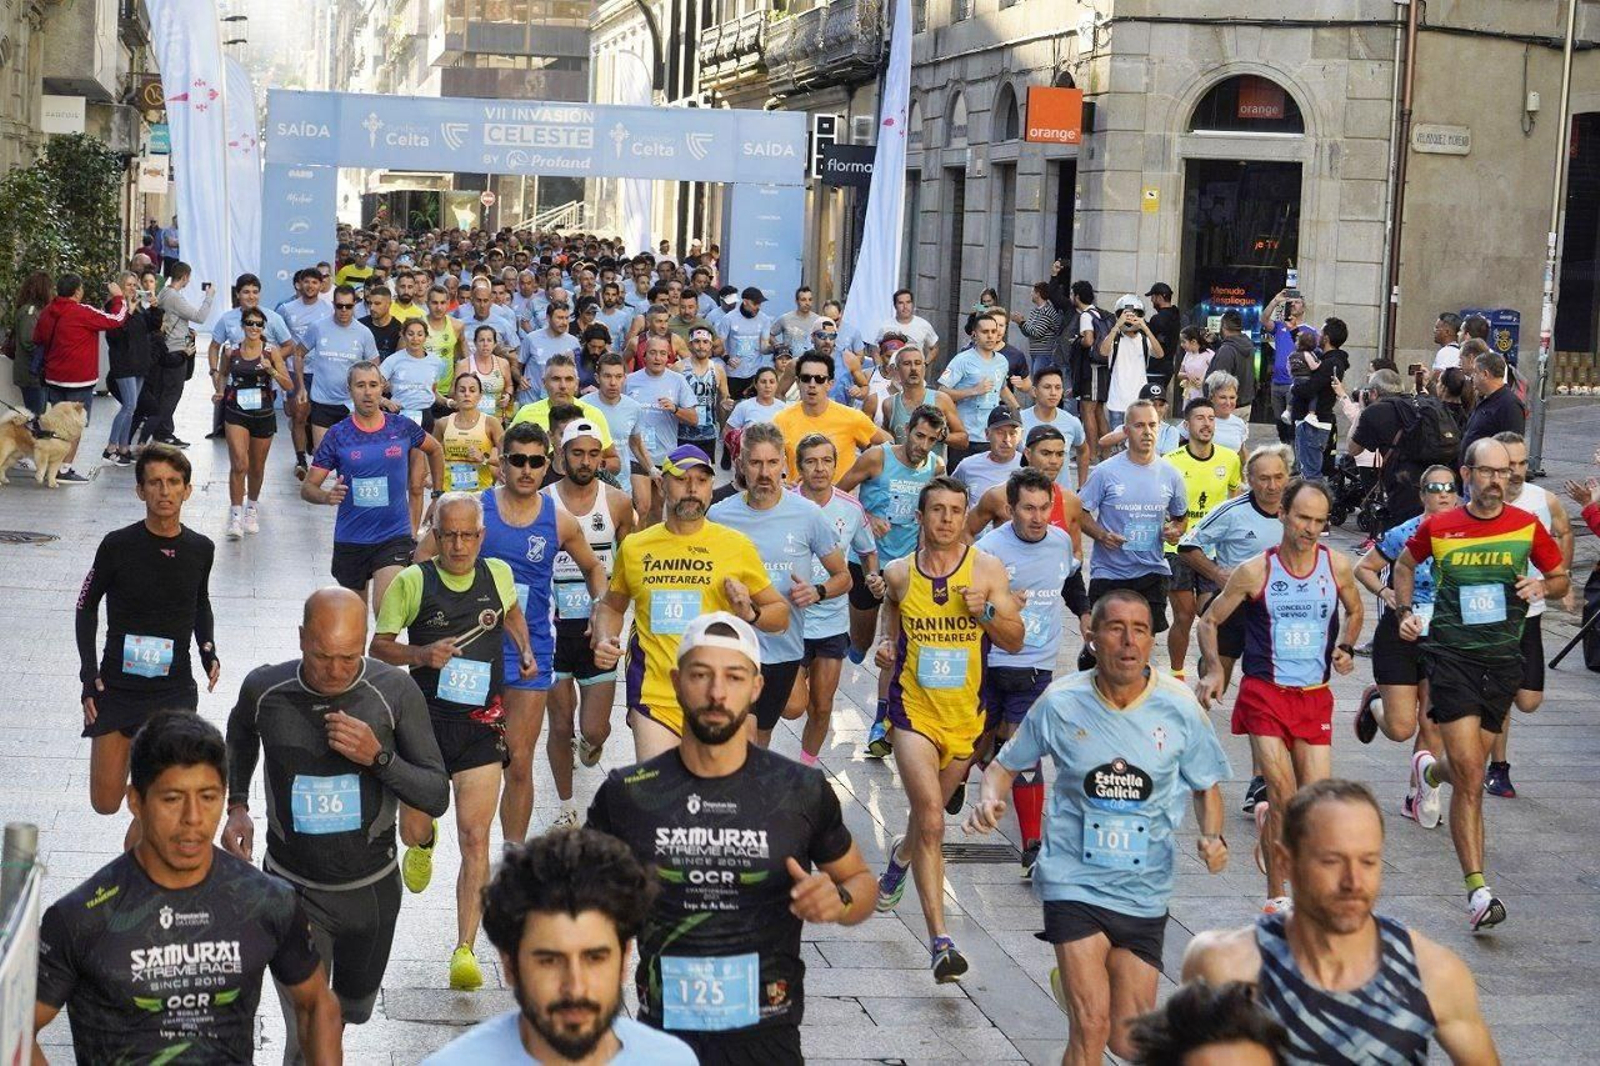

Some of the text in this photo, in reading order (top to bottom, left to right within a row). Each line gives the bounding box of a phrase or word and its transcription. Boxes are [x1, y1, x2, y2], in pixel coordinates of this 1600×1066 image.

[485, 107, 594, 123] VII INVASIÓN
[1240, 105, 1280, 117] orange
[278, 120, 331, 138] SAÍDA
[488, 125, 591, 147] CELESTE
[1029, 127, 1076, 142] orange
[386, 131, 430, 147] Celta
[631, 141, 675, 157] Celta
[743, 140, 795, 157] SAÍDA
[358, 486, 380, 498] 223
[643, 558, 714, 572] TANINOS
[1451, 551, 1514, 566] BIKILA
[642, 575, 712, 586] PONTEAREAS
[565, 594, 591, 607] 229
[1276, 604, 1312, 612] CONCELLO
[1468, 597, 1495, 611] 406
[664, 604, 684, 618] 40
[908, 616, 978, 631] TANINOS
[912, 632, 978, 643] PONTEAREAS
[1284, 632, 1311, 646] 383
[134, 648, 161, 664] 144
[932, 660, 951, 675] 36
[449, 671, 477, 690] 325
[1095, 771, 1143, 787] Estrella
[1096, 784, 1140, 800] Galicia
[305, 794, 343, 813] 136
[655, 827, 768, 848] SAMURAI
[1097, 830, 1130, 850] 101
[655, 845, 769, 859] XTREME RACE
[672, 857, 712, 866] SINCE
[689, 870, 735, 885] OCR
[130, 940, 240, 971] SAMURAI
[131, 961, 242, 983] XTREME RACE
[150, 976, 226, 991] SINCE 2015
[680, 980, 725, 1005] 125
[167, 993, 211, 1009] OCR
